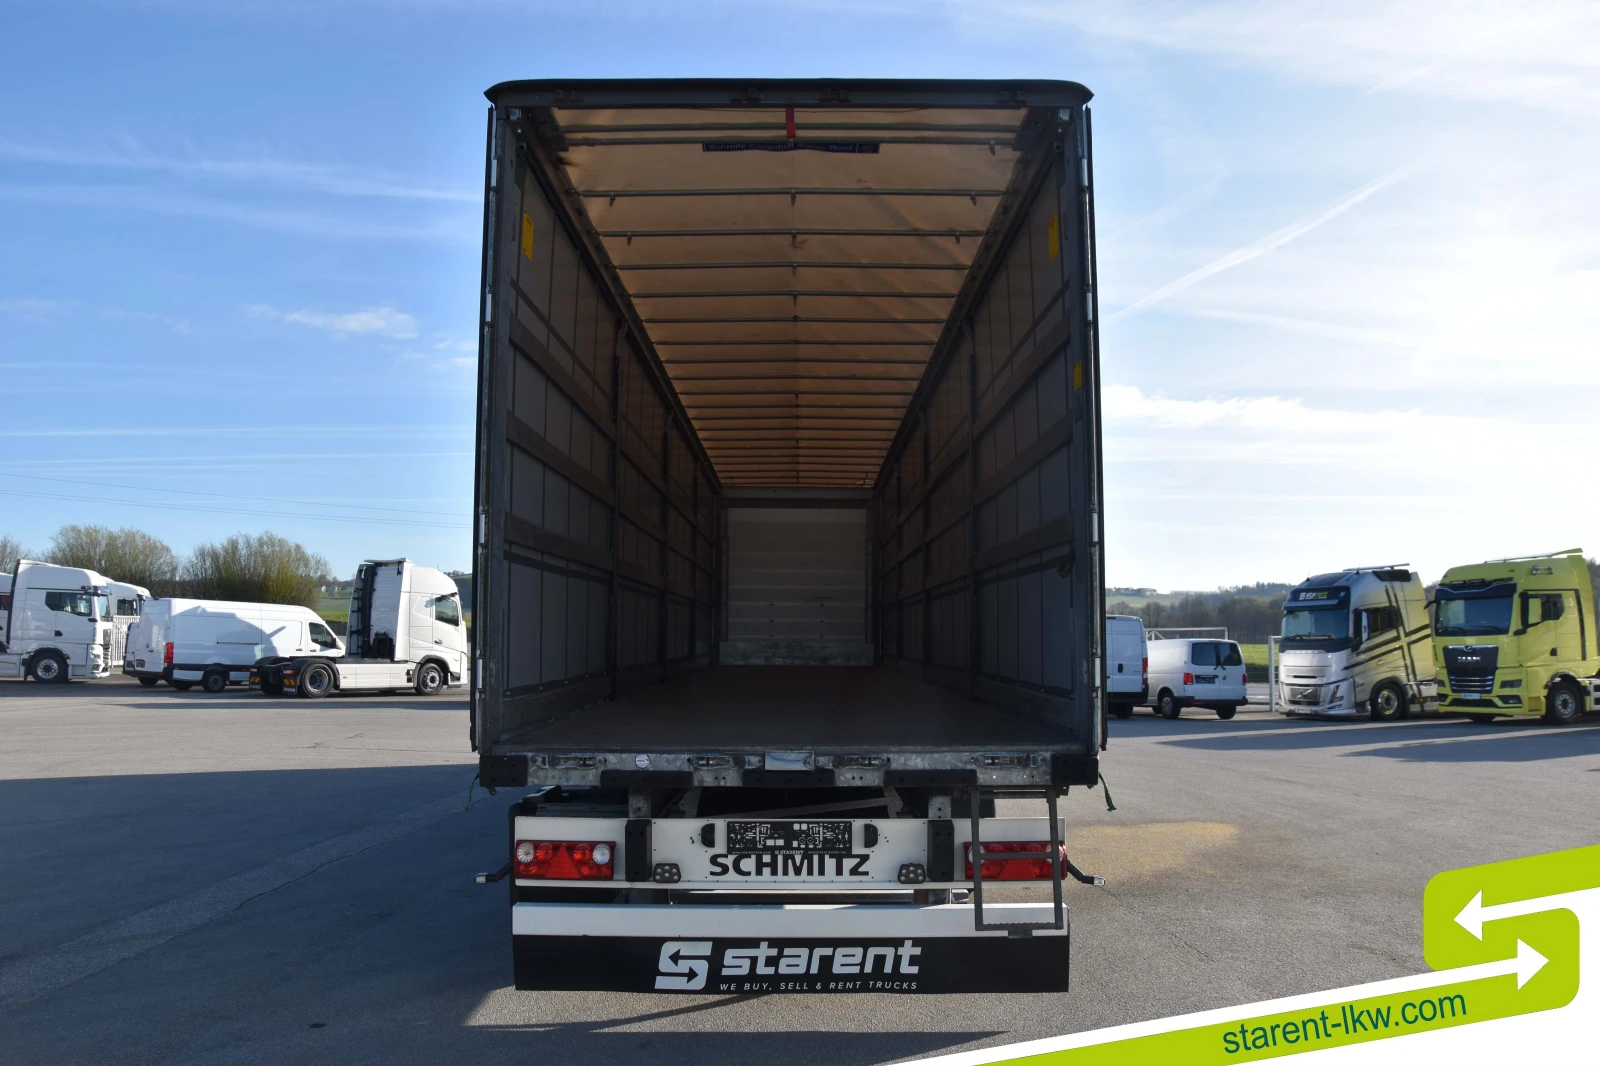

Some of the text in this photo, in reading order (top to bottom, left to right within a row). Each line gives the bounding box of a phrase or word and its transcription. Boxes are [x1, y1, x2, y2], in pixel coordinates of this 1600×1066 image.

[709, 854, 870, 876] SCHMITZ
[721, 940, 922, 975] starent
[744, 983, 772, 991] BUY,
[780, 982, 808, 990] SELL
[816, 981, 822, 989] &
[869, 981, 917, 989] TRUCKS
